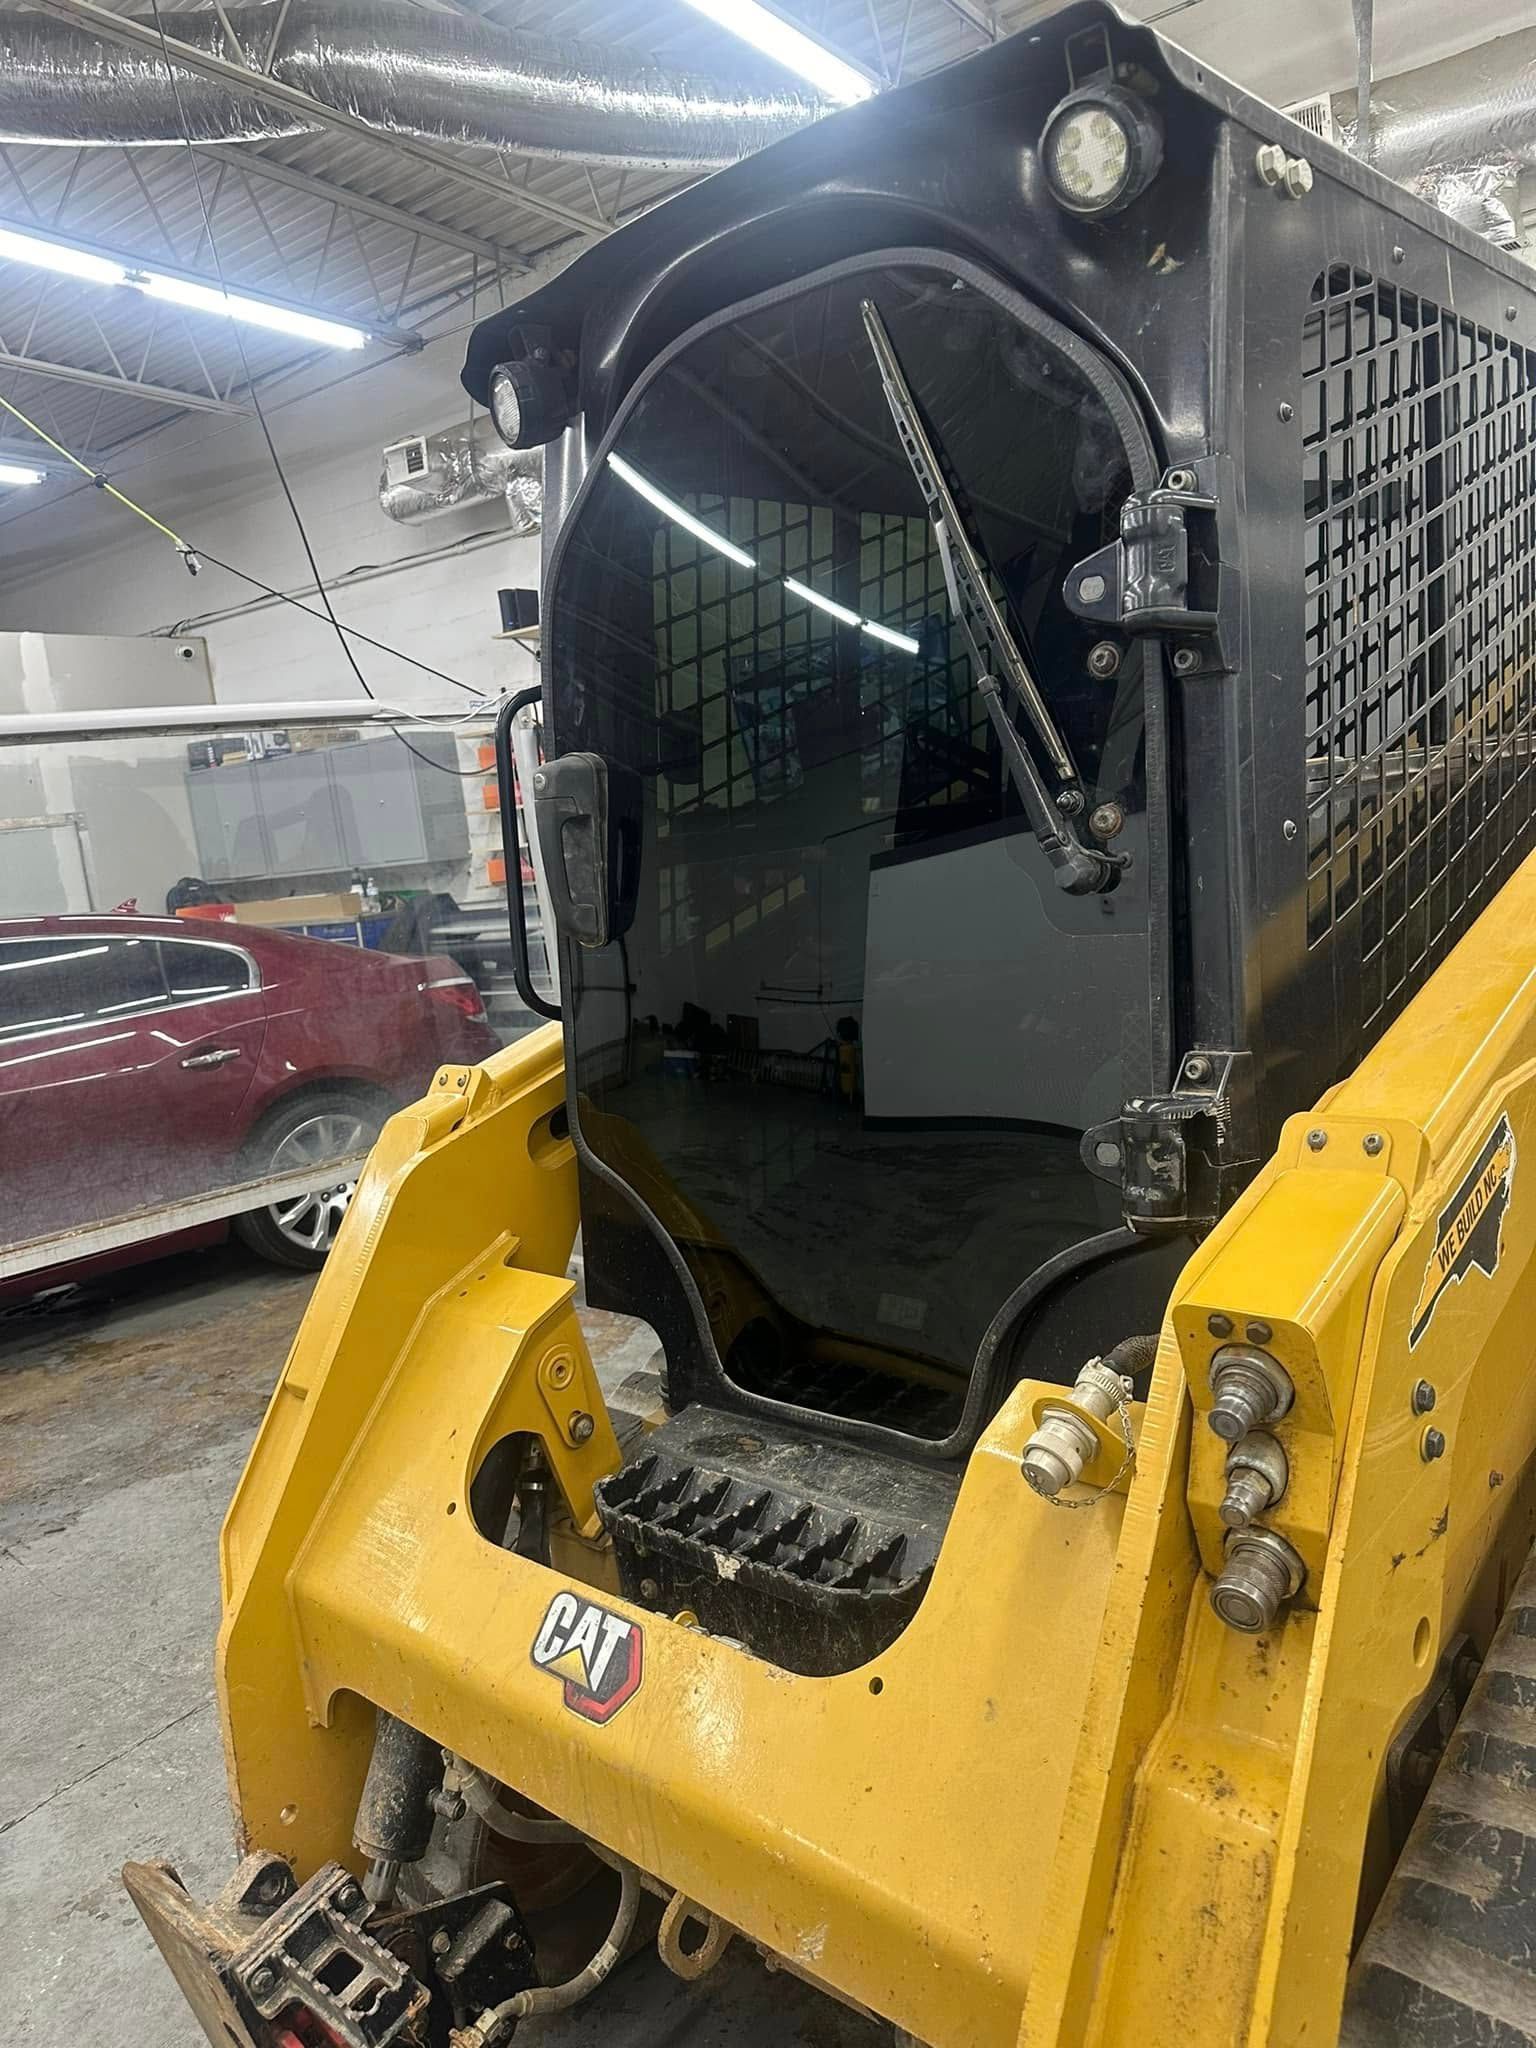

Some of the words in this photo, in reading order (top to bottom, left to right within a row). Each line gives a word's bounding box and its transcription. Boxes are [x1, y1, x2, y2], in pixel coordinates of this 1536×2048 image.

[1438, 1232, 1456, 1272] WE
[1456, 1188, 1483, 1245] BUILD
[1483, 1163, 1497, 1199] NC
[533, 1593, 632, 1692] CAT
